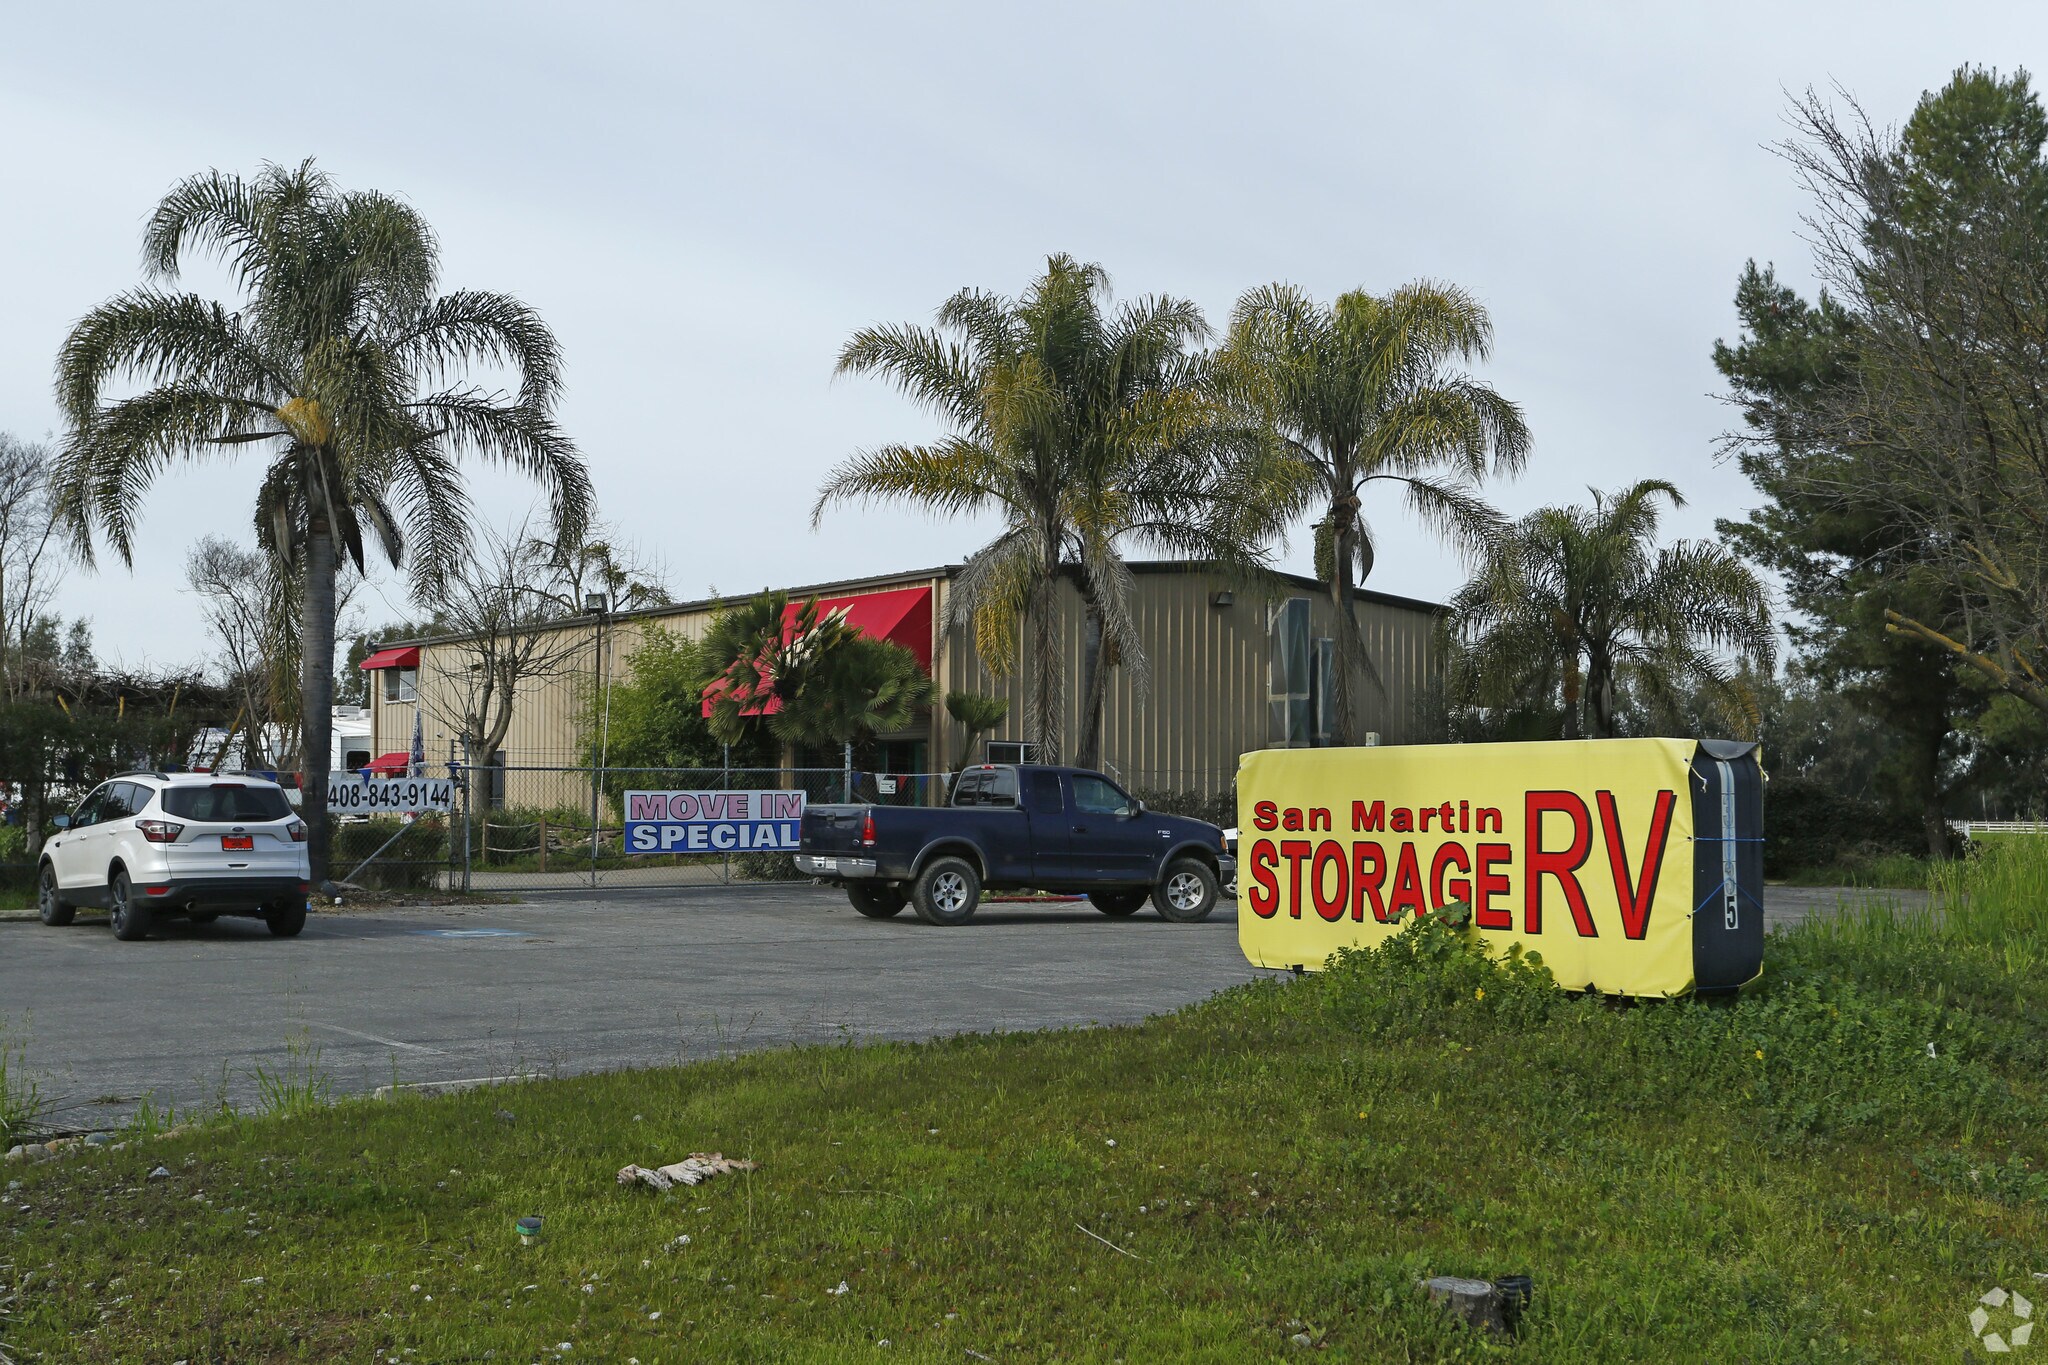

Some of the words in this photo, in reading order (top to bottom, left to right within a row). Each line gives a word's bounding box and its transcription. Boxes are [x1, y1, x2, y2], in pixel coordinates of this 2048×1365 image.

[328, 784, 450, 807] 408-843-9144
[630, 794, 749, 820] MOVE
[760, 793, 801, 819] IN
[1253, 800, 1332, 832] San
[1351, 800, 1502, 833] Martin
[631, 823, 800, 850] SPECIAL
[1524, 790, 1677, 940] RV
[1248, 838, 1513, 931] STORAGE
